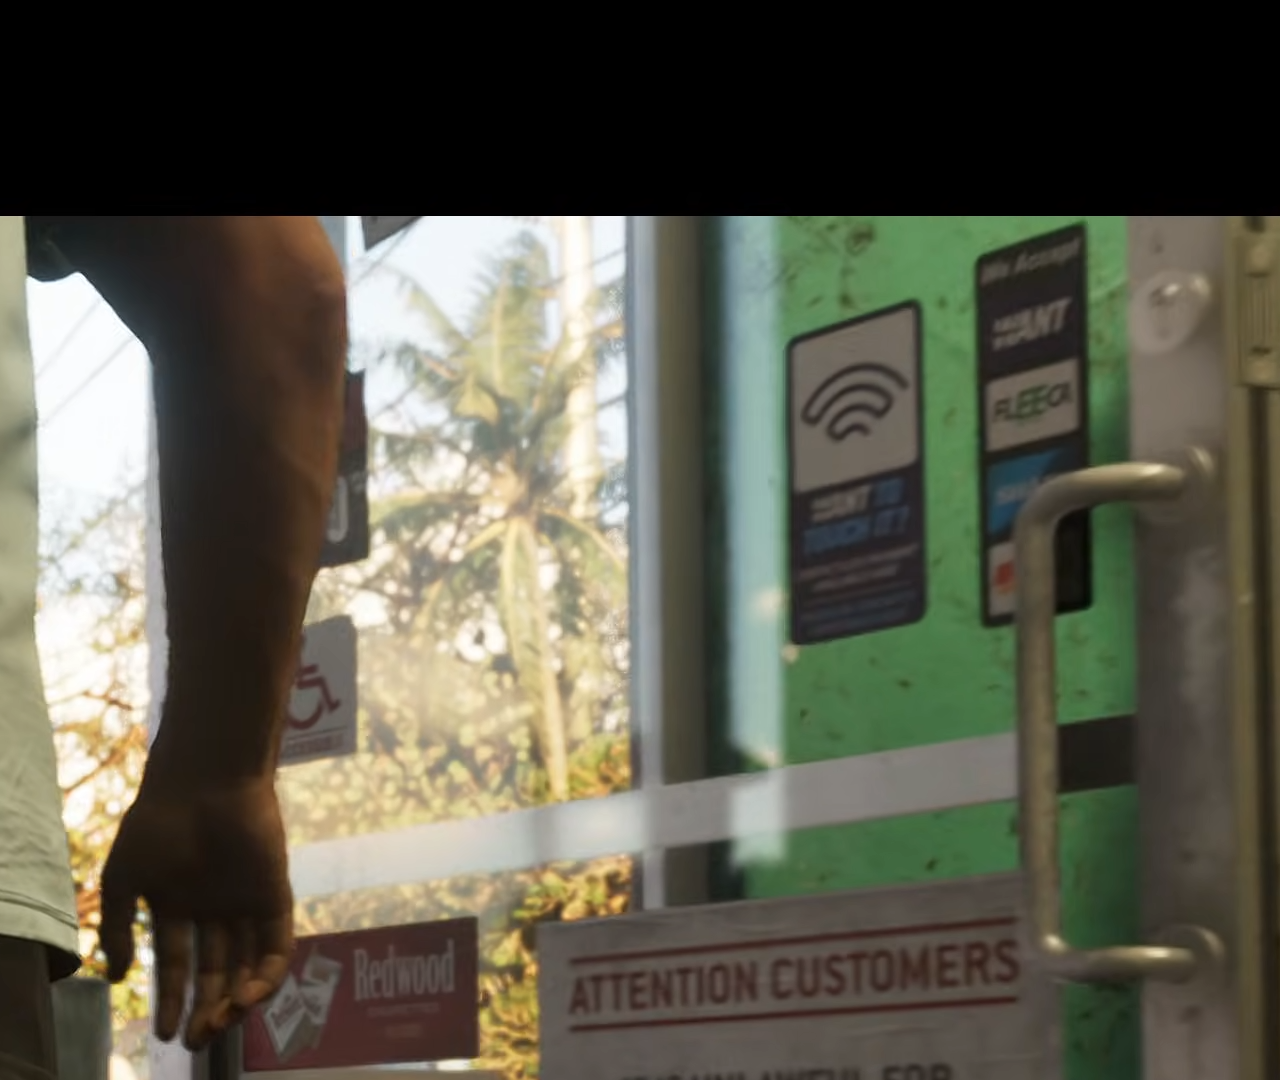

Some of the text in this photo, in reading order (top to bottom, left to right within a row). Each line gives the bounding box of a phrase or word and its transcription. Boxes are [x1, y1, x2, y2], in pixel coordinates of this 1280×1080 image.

[353, 936, 456, 1002] Redwood
[568, 939, 1021, 1016] ATTENTION CUSTOMERS
